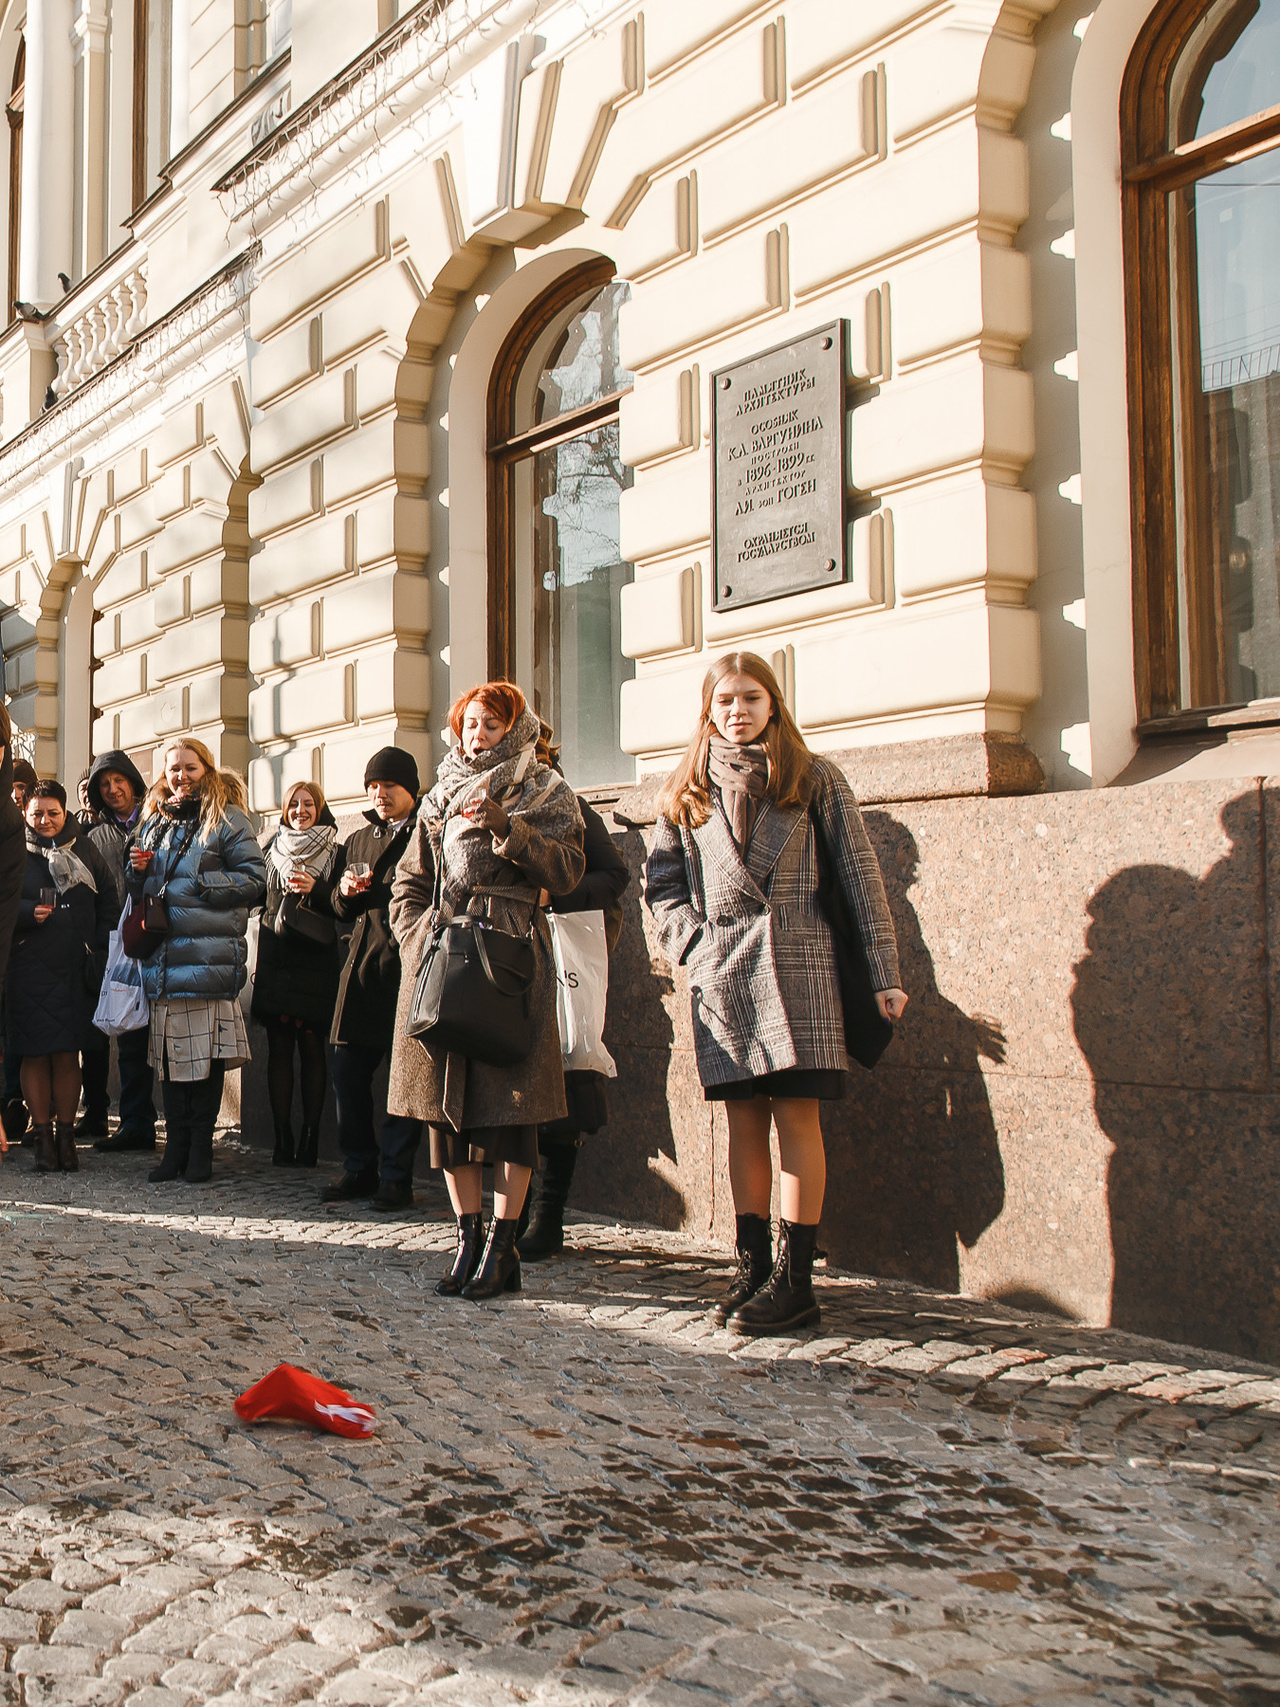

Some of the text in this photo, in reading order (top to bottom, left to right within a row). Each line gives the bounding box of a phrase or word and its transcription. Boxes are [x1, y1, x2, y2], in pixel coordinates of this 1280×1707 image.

[736, 376, 815, 417] АРХИТЕКТУРЫ
[744, 368, 806, 402] ПАМЯТНИК
[751, 409, 798, 435] ОСОБНЯК
[751, 416, 823, 453] ВАРГУНИНА
[777, 478, 816, 503] ГОГЕН
[737, 532, 815, 563] ГОСУДАРСТВОМ
[744, 522, 808, 549] ОХРАНЯЕТСЯ
